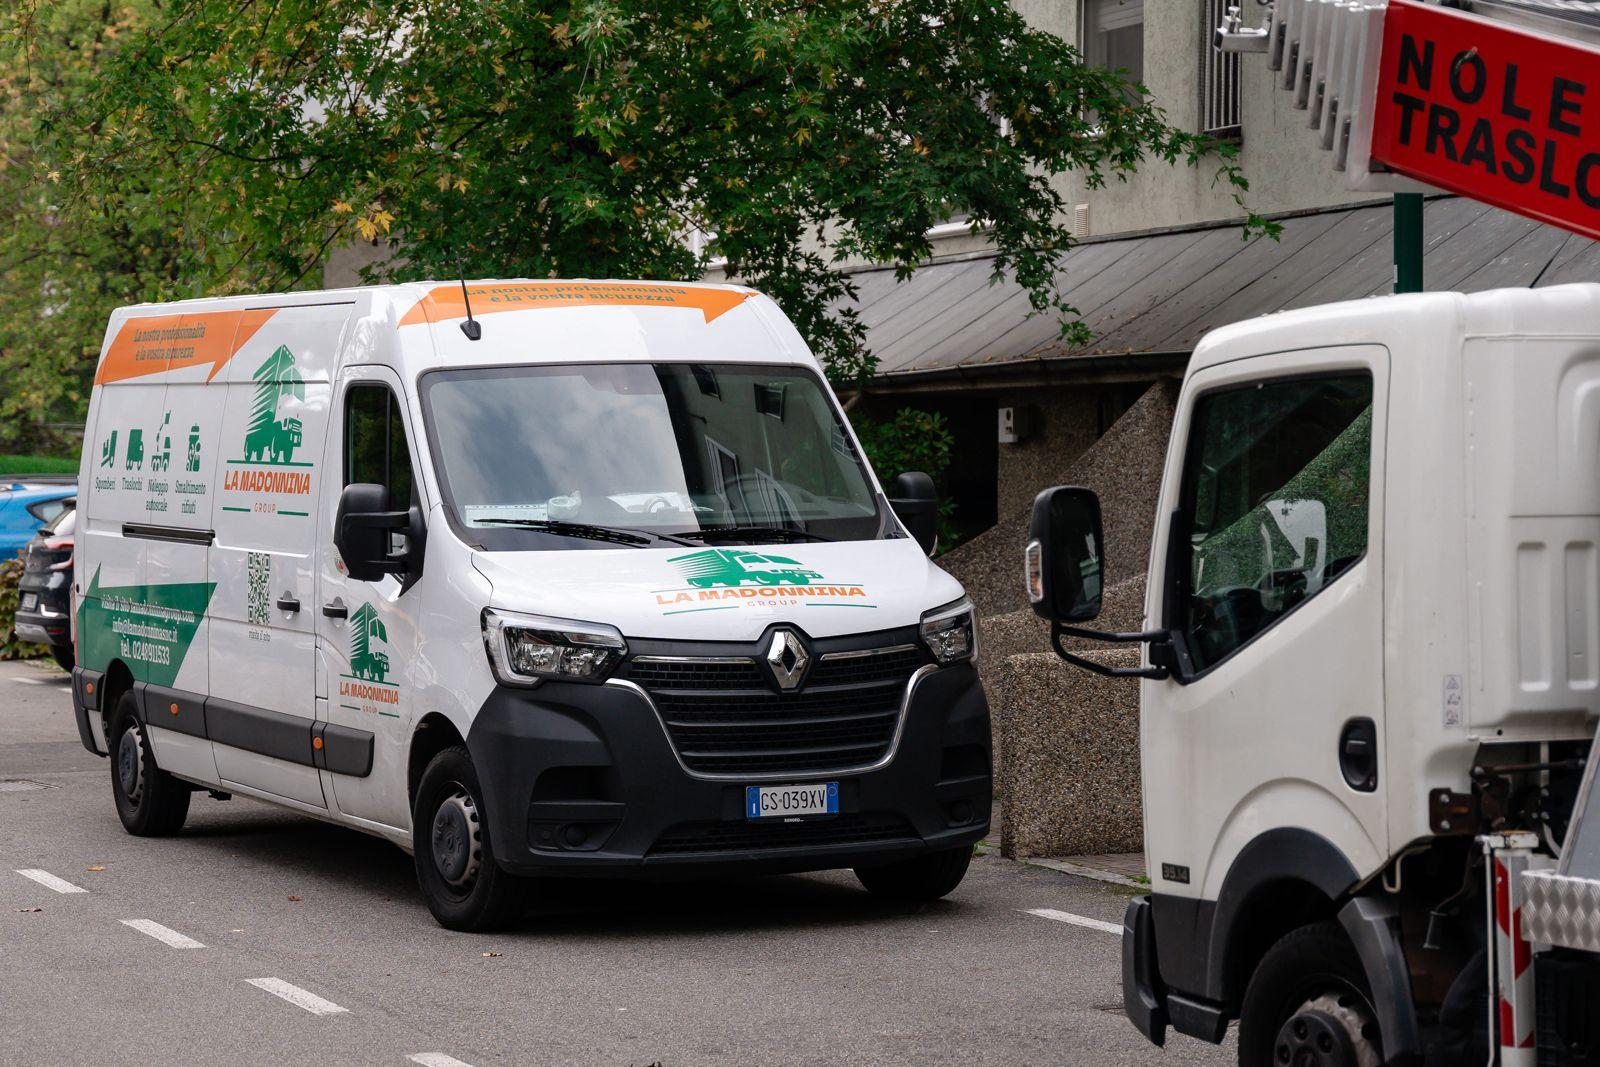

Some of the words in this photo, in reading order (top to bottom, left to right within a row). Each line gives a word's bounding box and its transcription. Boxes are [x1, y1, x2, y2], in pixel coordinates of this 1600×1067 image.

[491, 285, 549, 294] nostra
[528, 293, 584, 301] vostra
[590, 293, 675, 302] sicurezza
[122, 476, 143, 491] Traslochi
[223, 470, 239, 491] LA
[239, 470, 311, 495] MADONNINA
[254, 502, 276, 513] GROUP
[655, 591, 694, 605] LA
[699, 585, 866, 601] MADONNINA
[747, 599, 798, 607] GROUP
[120, 638, 132, 658] tel.
[339, 681, 350, 696] LA
[350, 683, 399, 704] MADONNINA
